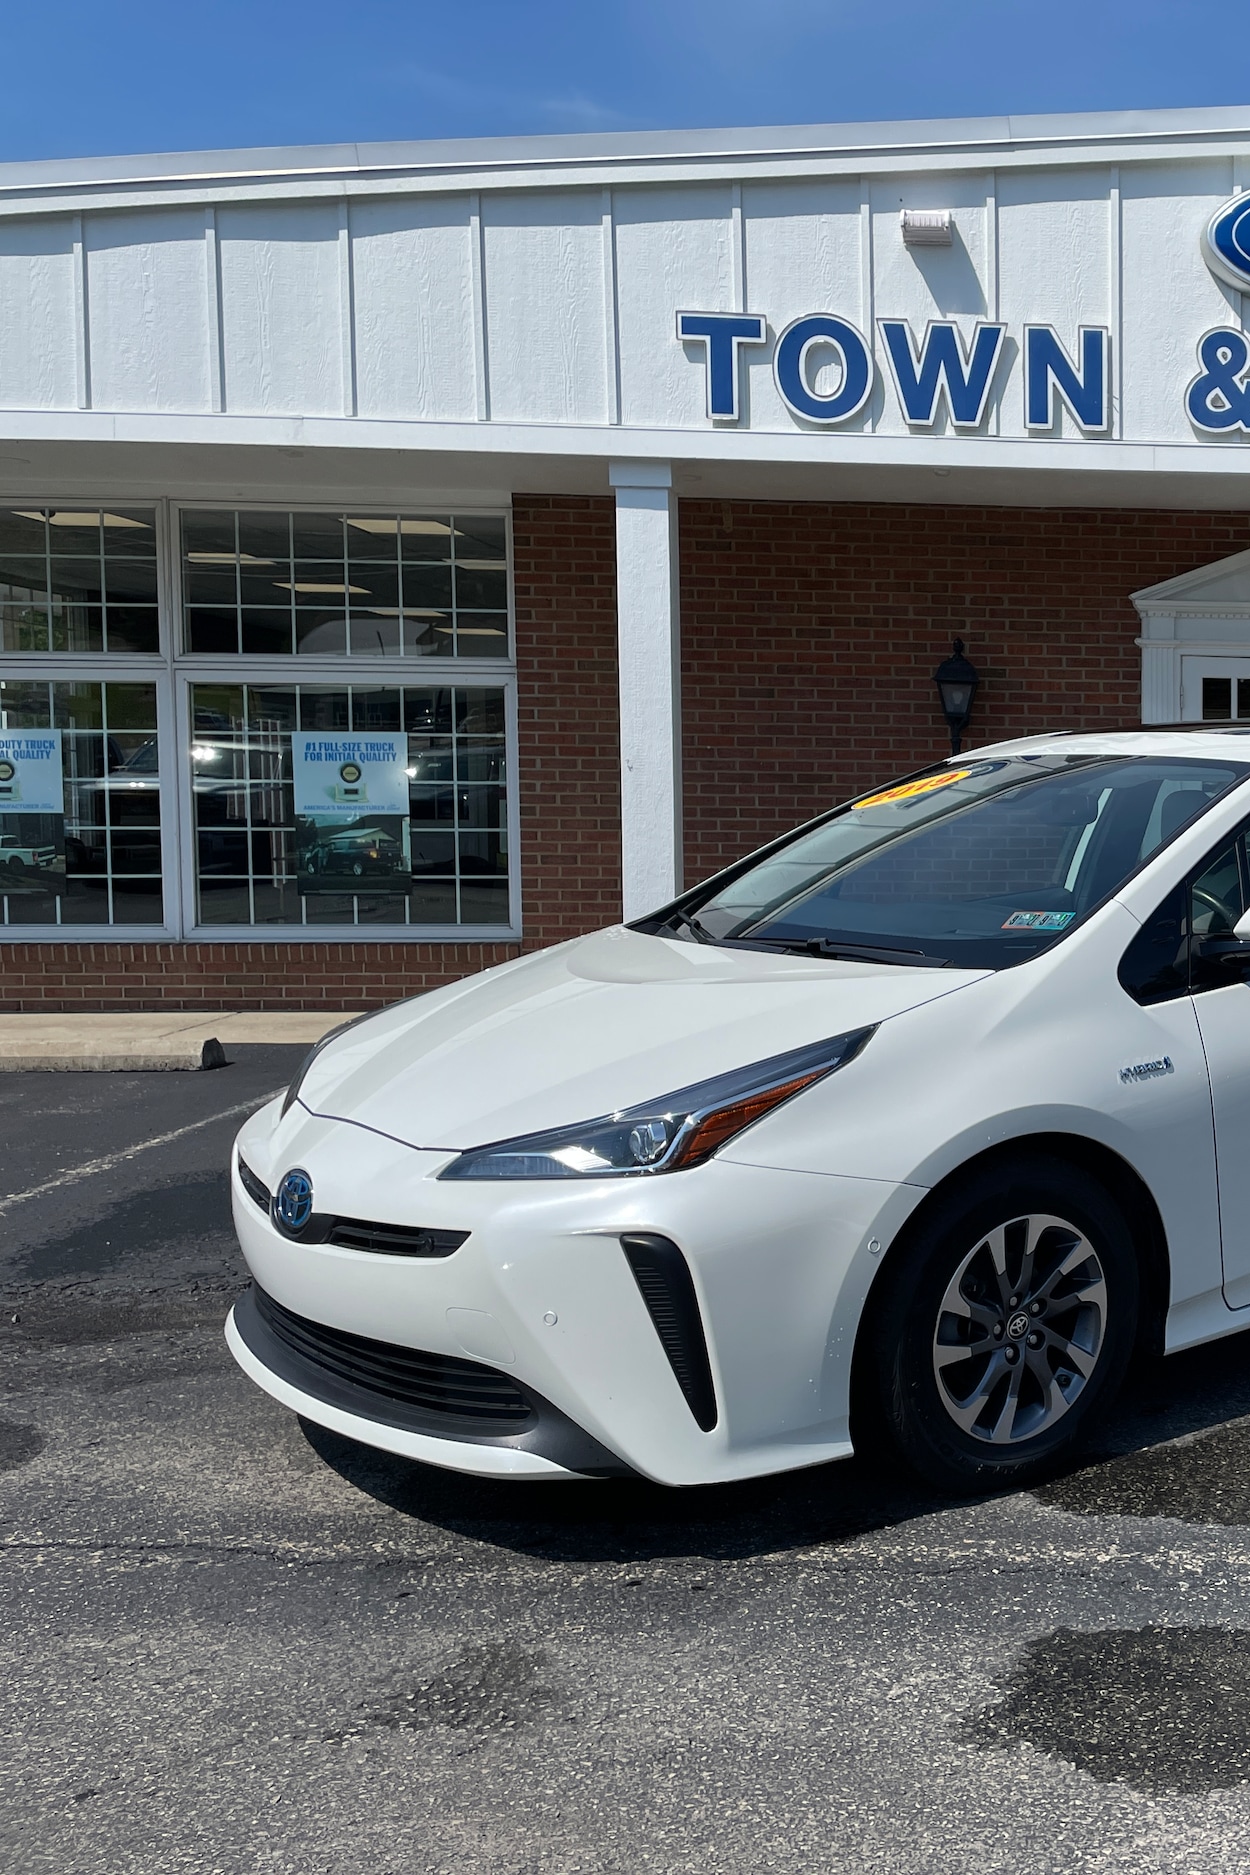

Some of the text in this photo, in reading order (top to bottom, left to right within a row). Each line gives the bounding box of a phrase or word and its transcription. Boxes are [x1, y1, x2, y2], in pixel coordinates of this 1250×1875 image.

[676, 311, 1109, 432] TOWN
[24, 740, 55, 750] TRUCK
[305, 742, 394, 752] #1 FULL-SIZE TRUCK
[13, 750, 51, 761] QUALITY
[304, 752, 397, 763] FOR INITIAL QUALITY
